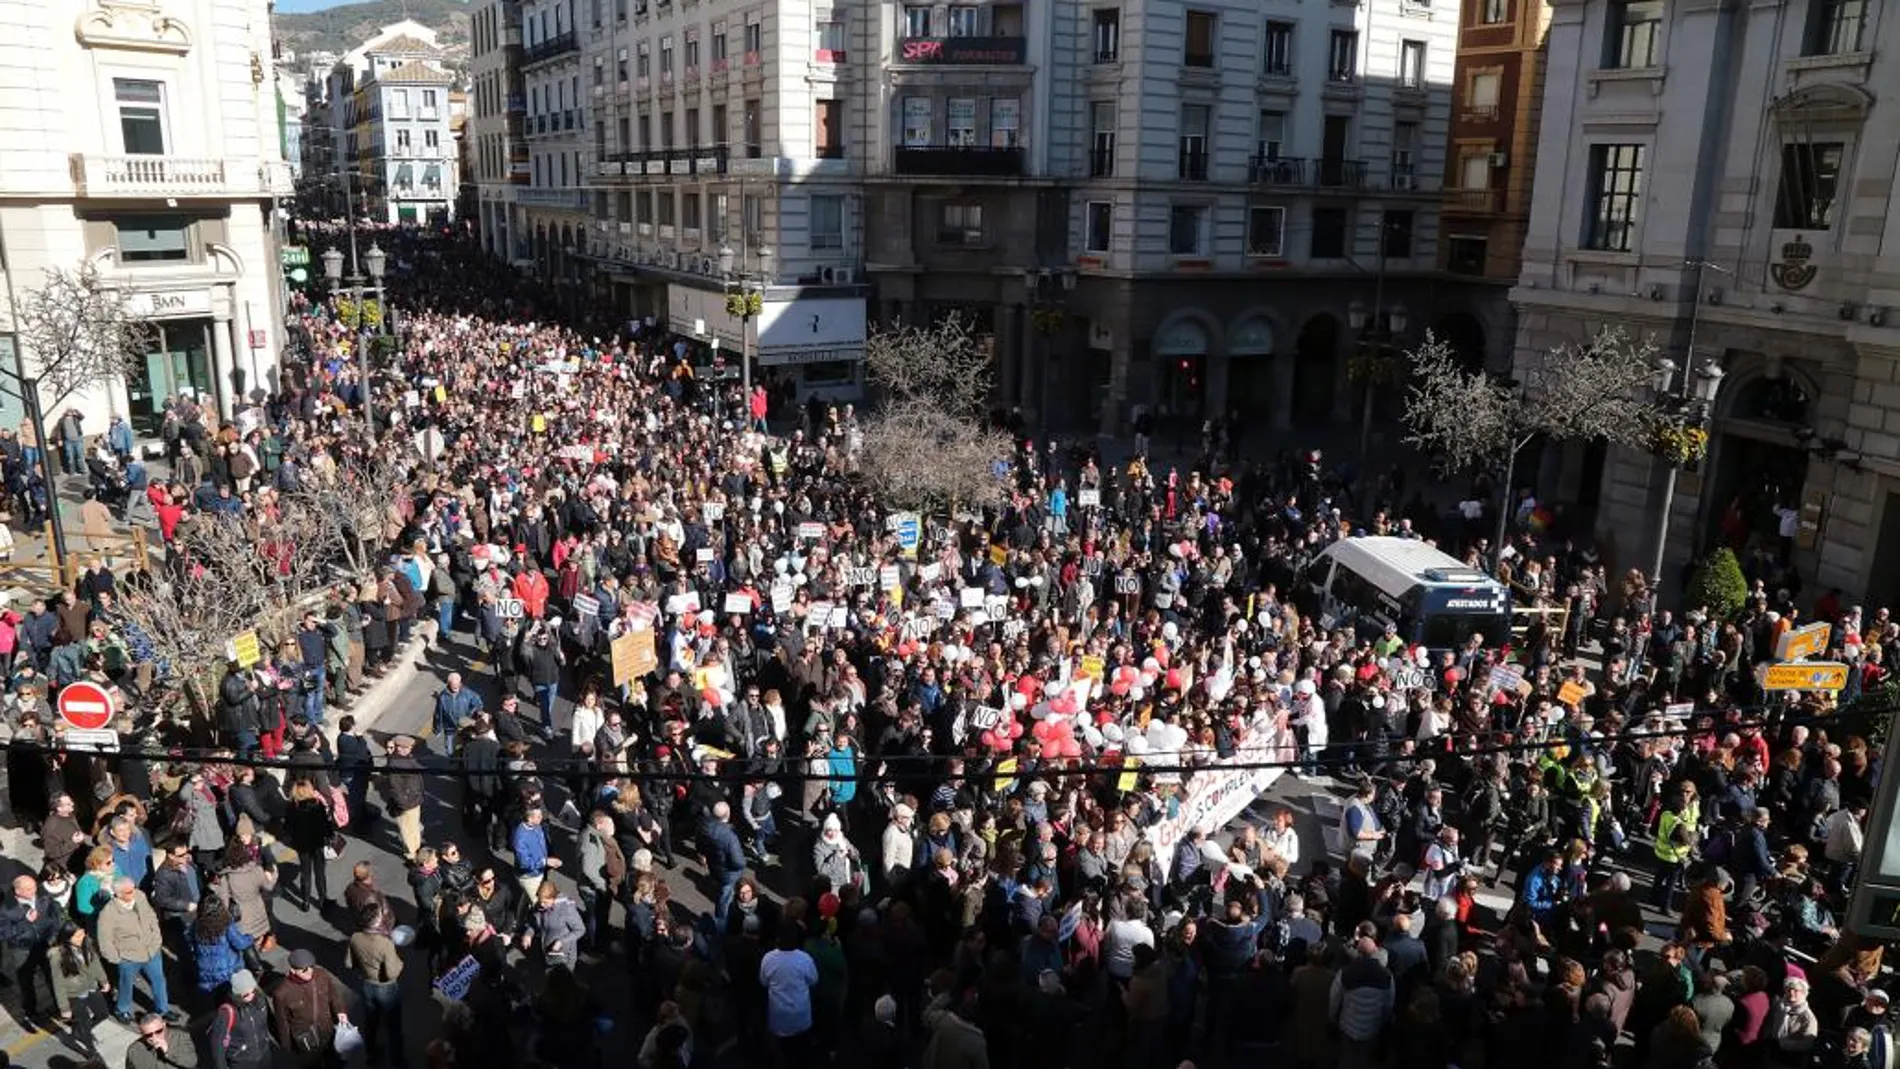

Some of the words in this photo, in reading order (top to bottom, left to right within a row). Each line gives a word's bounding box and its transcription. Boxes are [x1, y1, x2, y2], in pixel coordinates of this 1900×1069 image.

[903, 41, 943, 60] SPA
[281, 253, 305, 263] 24H
[152, 294, 185, 310] BMN
[852, 567, 876, 584] NO
[1116, 577, 1138, 592] NO
[497, 600, 521, 616] NO
[984, 603, 1005, 620] NO
[1446, 599, 1488, 608] ATESTADOS
[907, 618, 931, 637] NO
[1396, 670, 1422, 687] NO
[975, 708, 998, 729] NO
